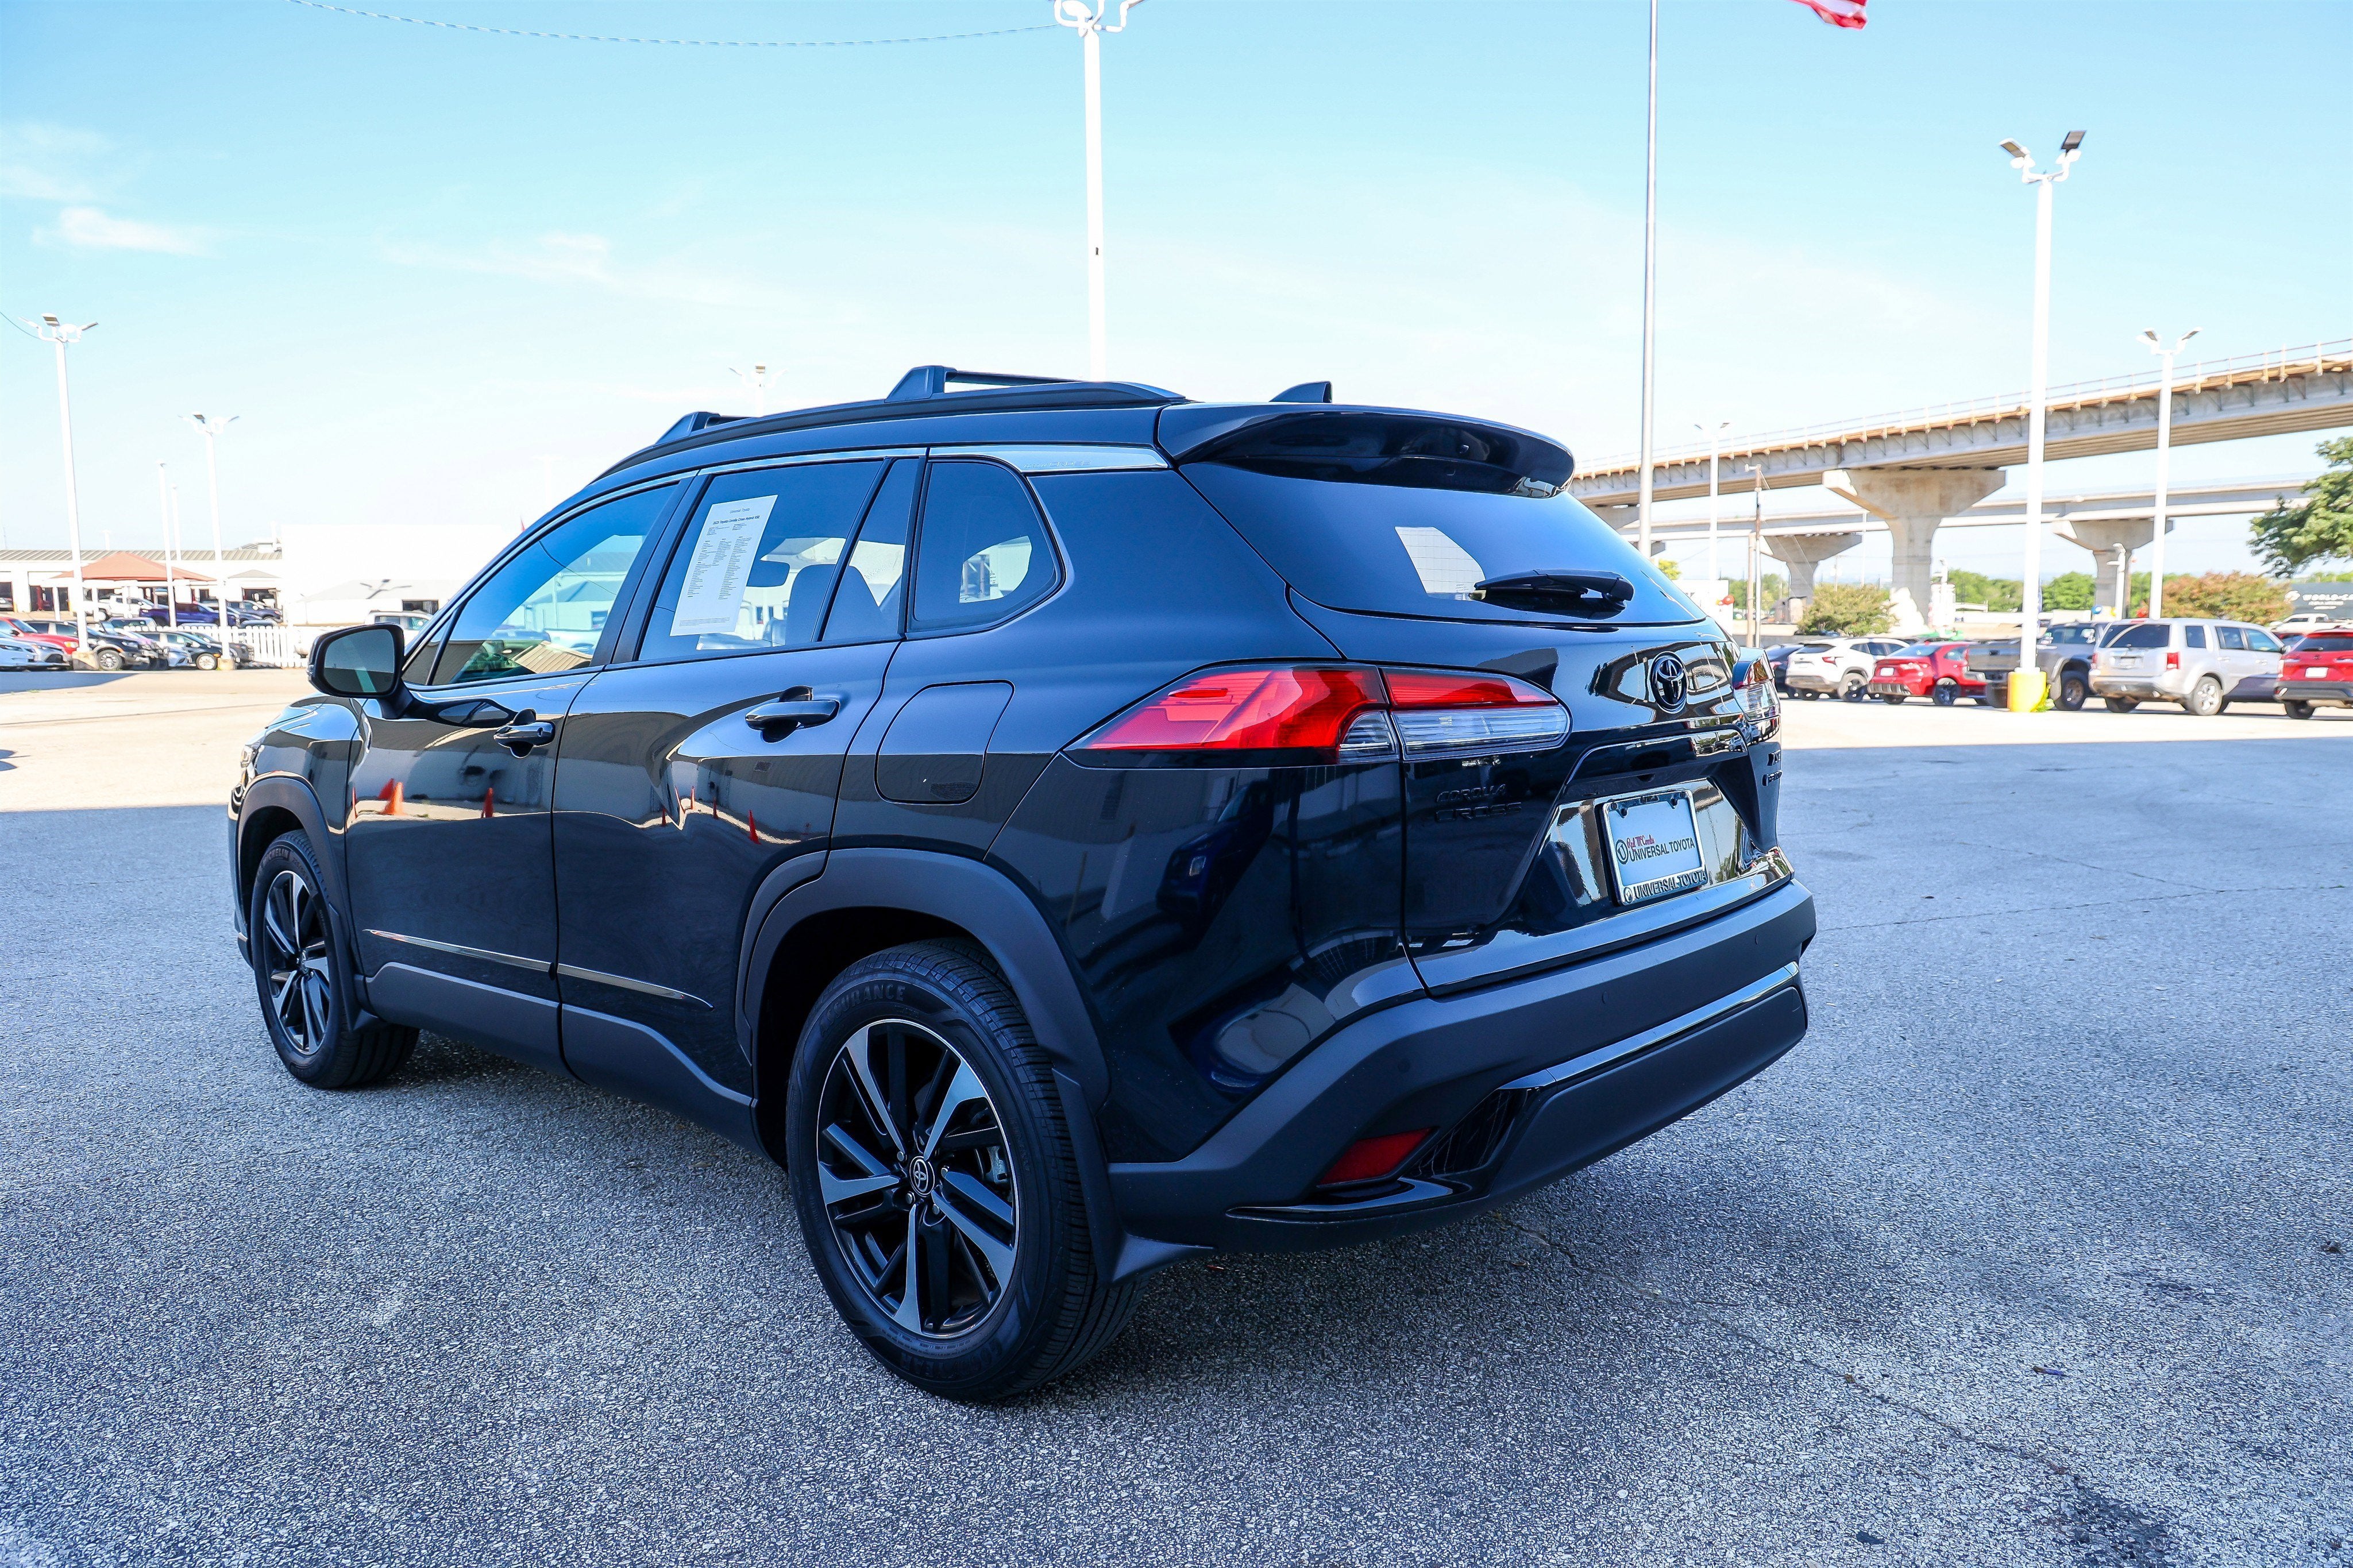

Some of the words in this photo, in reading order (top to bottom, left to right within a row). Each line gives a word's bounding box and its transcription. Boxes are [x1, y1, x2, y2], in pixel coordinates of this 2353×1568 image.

[1436, 783, 1506, 803] COROLLA
[1435, 802, 1522, 822] CROSS
[1629, 843, 1669, 862] UNIVERSAL
[1669, 837, 1695, 853] TOYOTA
[1633, 877, 1679, 899] UNIVERSAL
[1677, 870, 1707, 887] TOYOTA
[820, 984, 906, 1037] ASSURANCE
